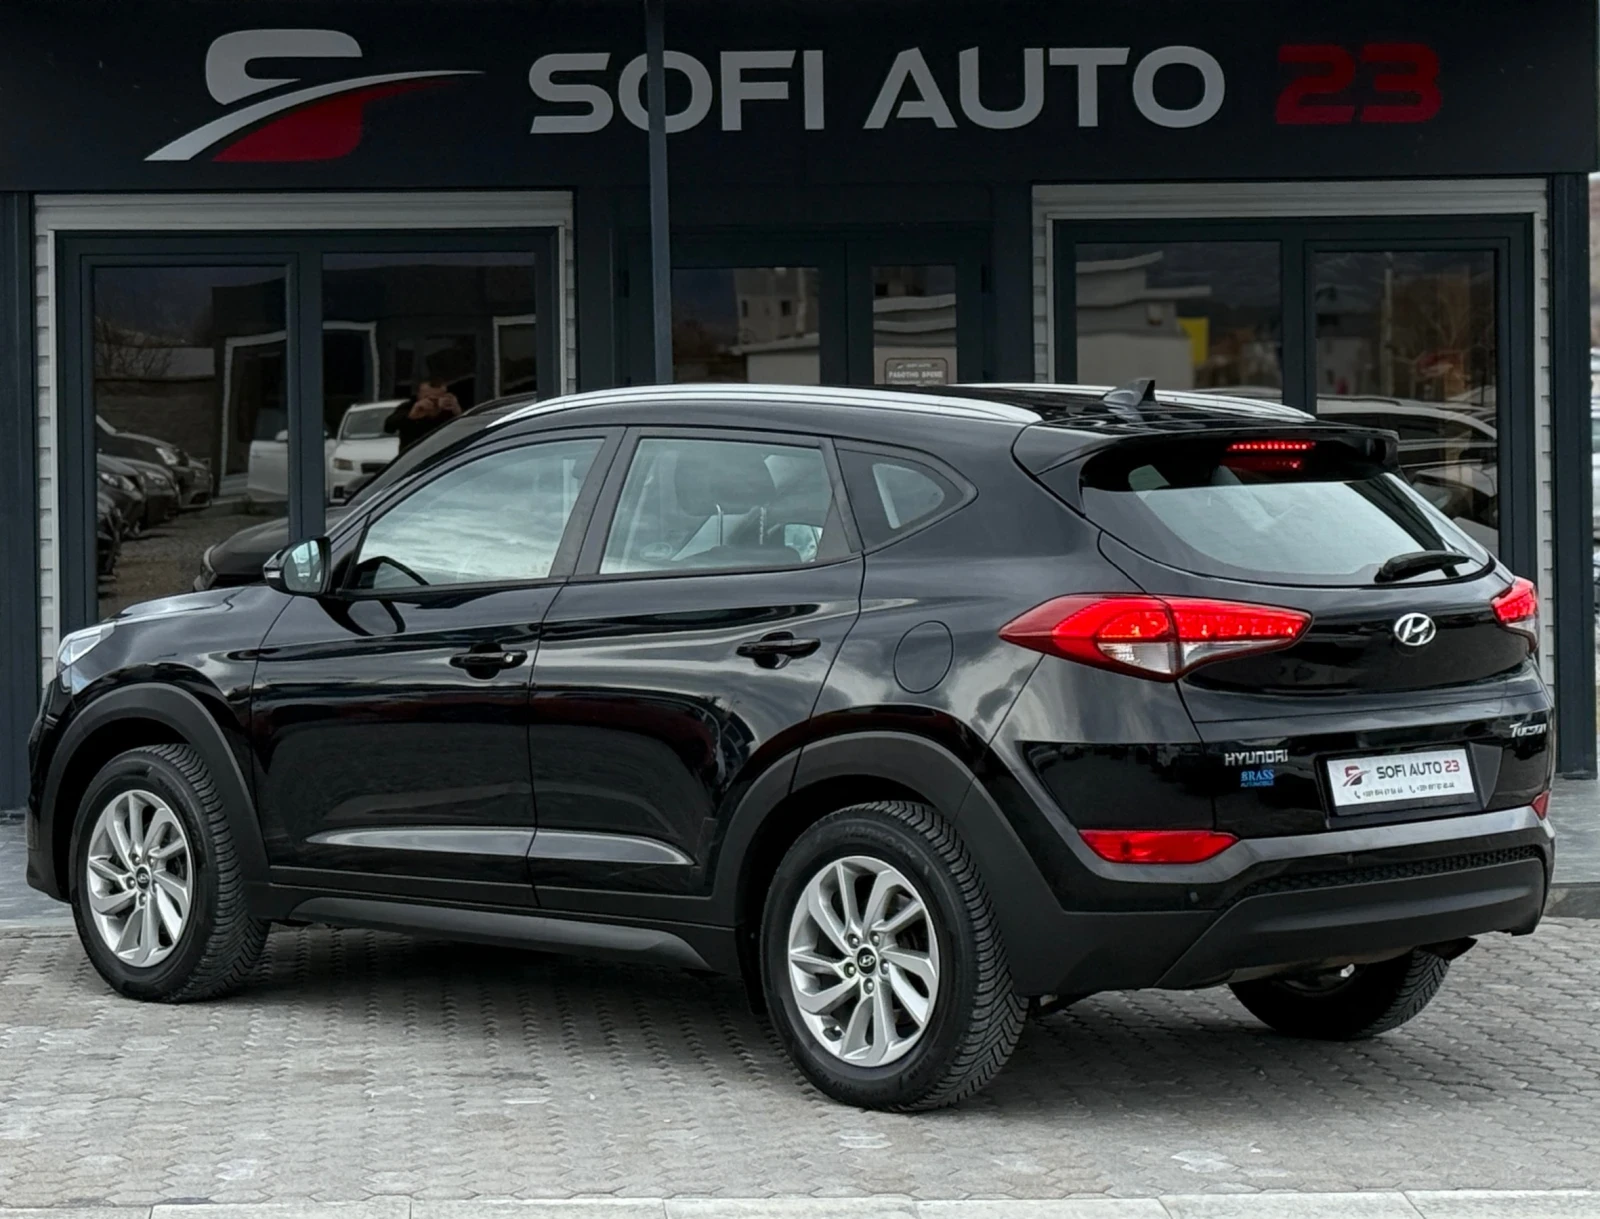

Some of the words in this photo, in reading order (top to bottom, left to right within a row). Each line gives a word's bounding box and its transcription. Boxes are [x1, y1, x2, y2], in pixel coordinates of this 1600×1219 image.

[528, 50, 825, 134] SOFI
[863, 45, 1225, 129] AUTO
[1275, 43, 1442, 125] 23
[1509, 721, 1547, 738] Tucson
[1224, 749, 1288, 767] HYUNDAI
[1240, 768, 1275, 782] BRASS
[1376, 764, 1407, 780] SOFI
[1409, 761, 1443, 777] AUTO
[1443, 759, 1461, 773] 23
